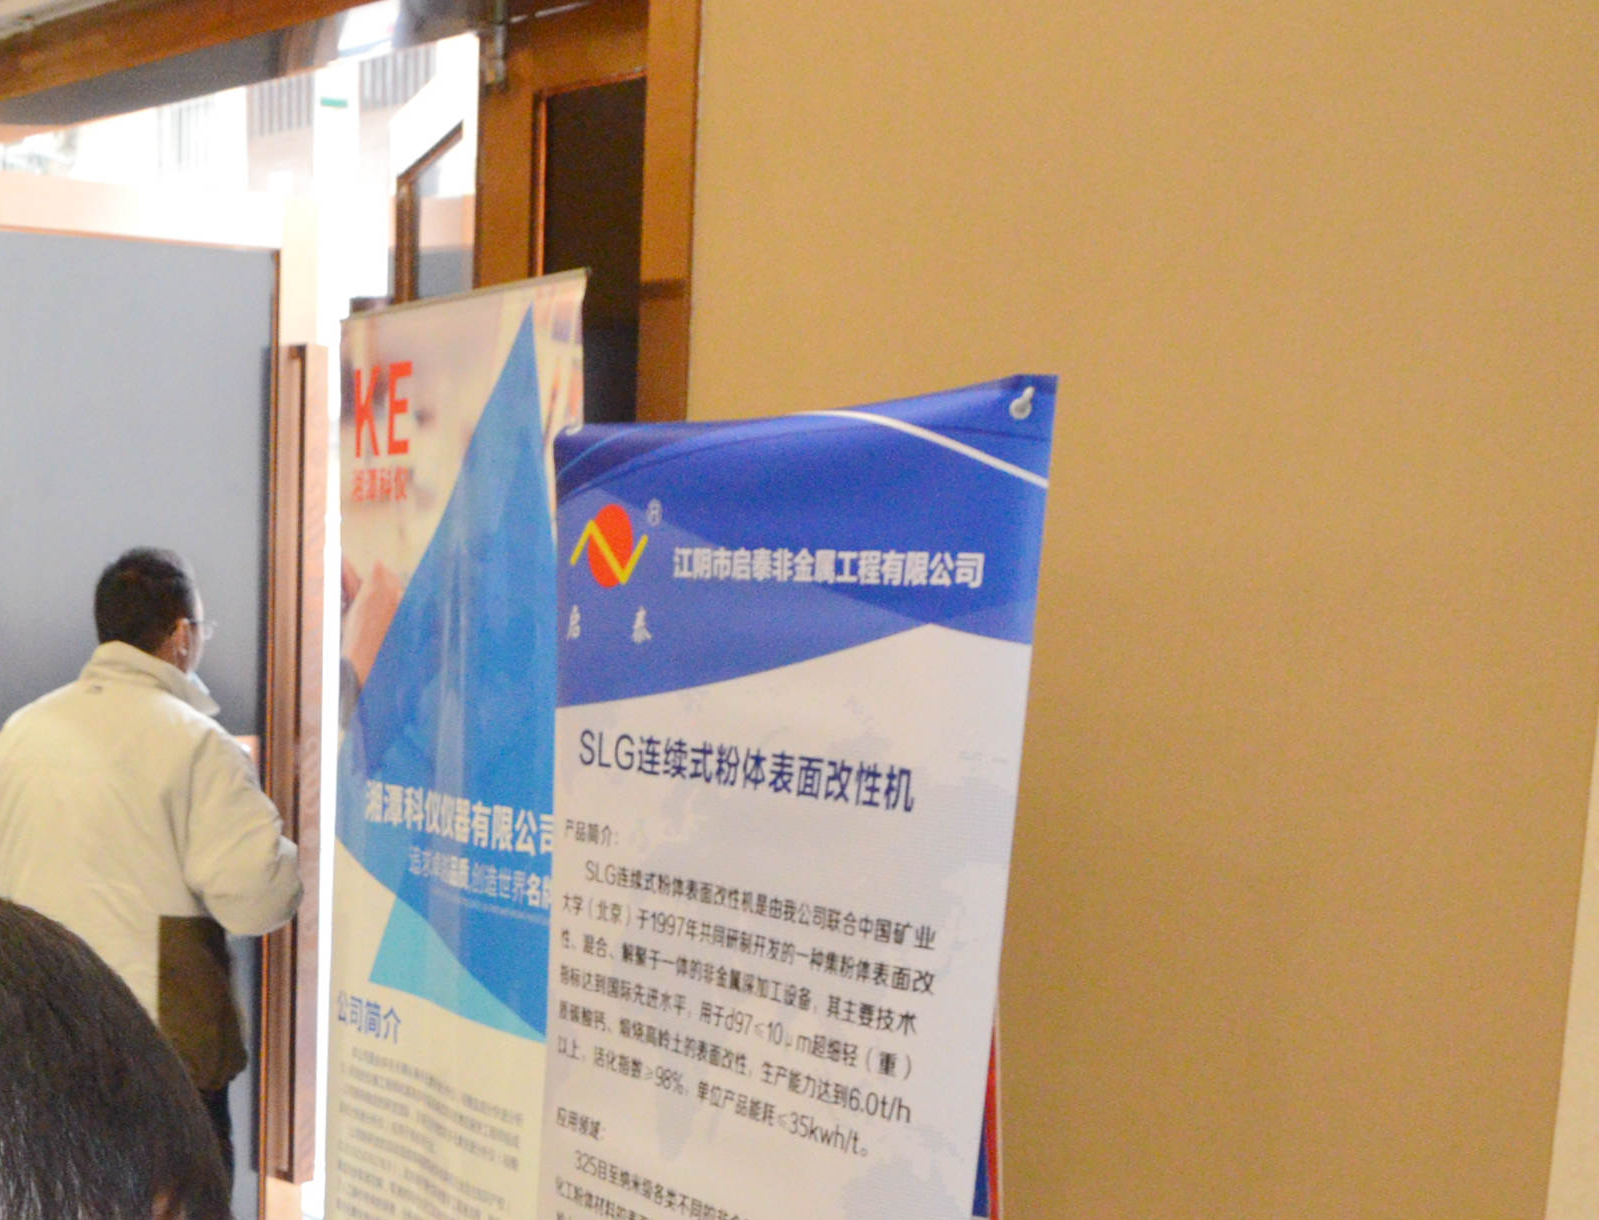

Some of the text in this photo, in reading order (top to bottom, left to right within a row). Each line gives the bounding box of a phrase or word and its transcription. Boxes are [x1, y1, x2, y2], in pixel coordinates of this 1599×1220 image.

[353, 360, 413, 459] KE
[674, 547, 985, 588] 江阴市启泰非金属工程有限公司
[579, 729, 915, 813] SLG连续式粉体表面改性机
